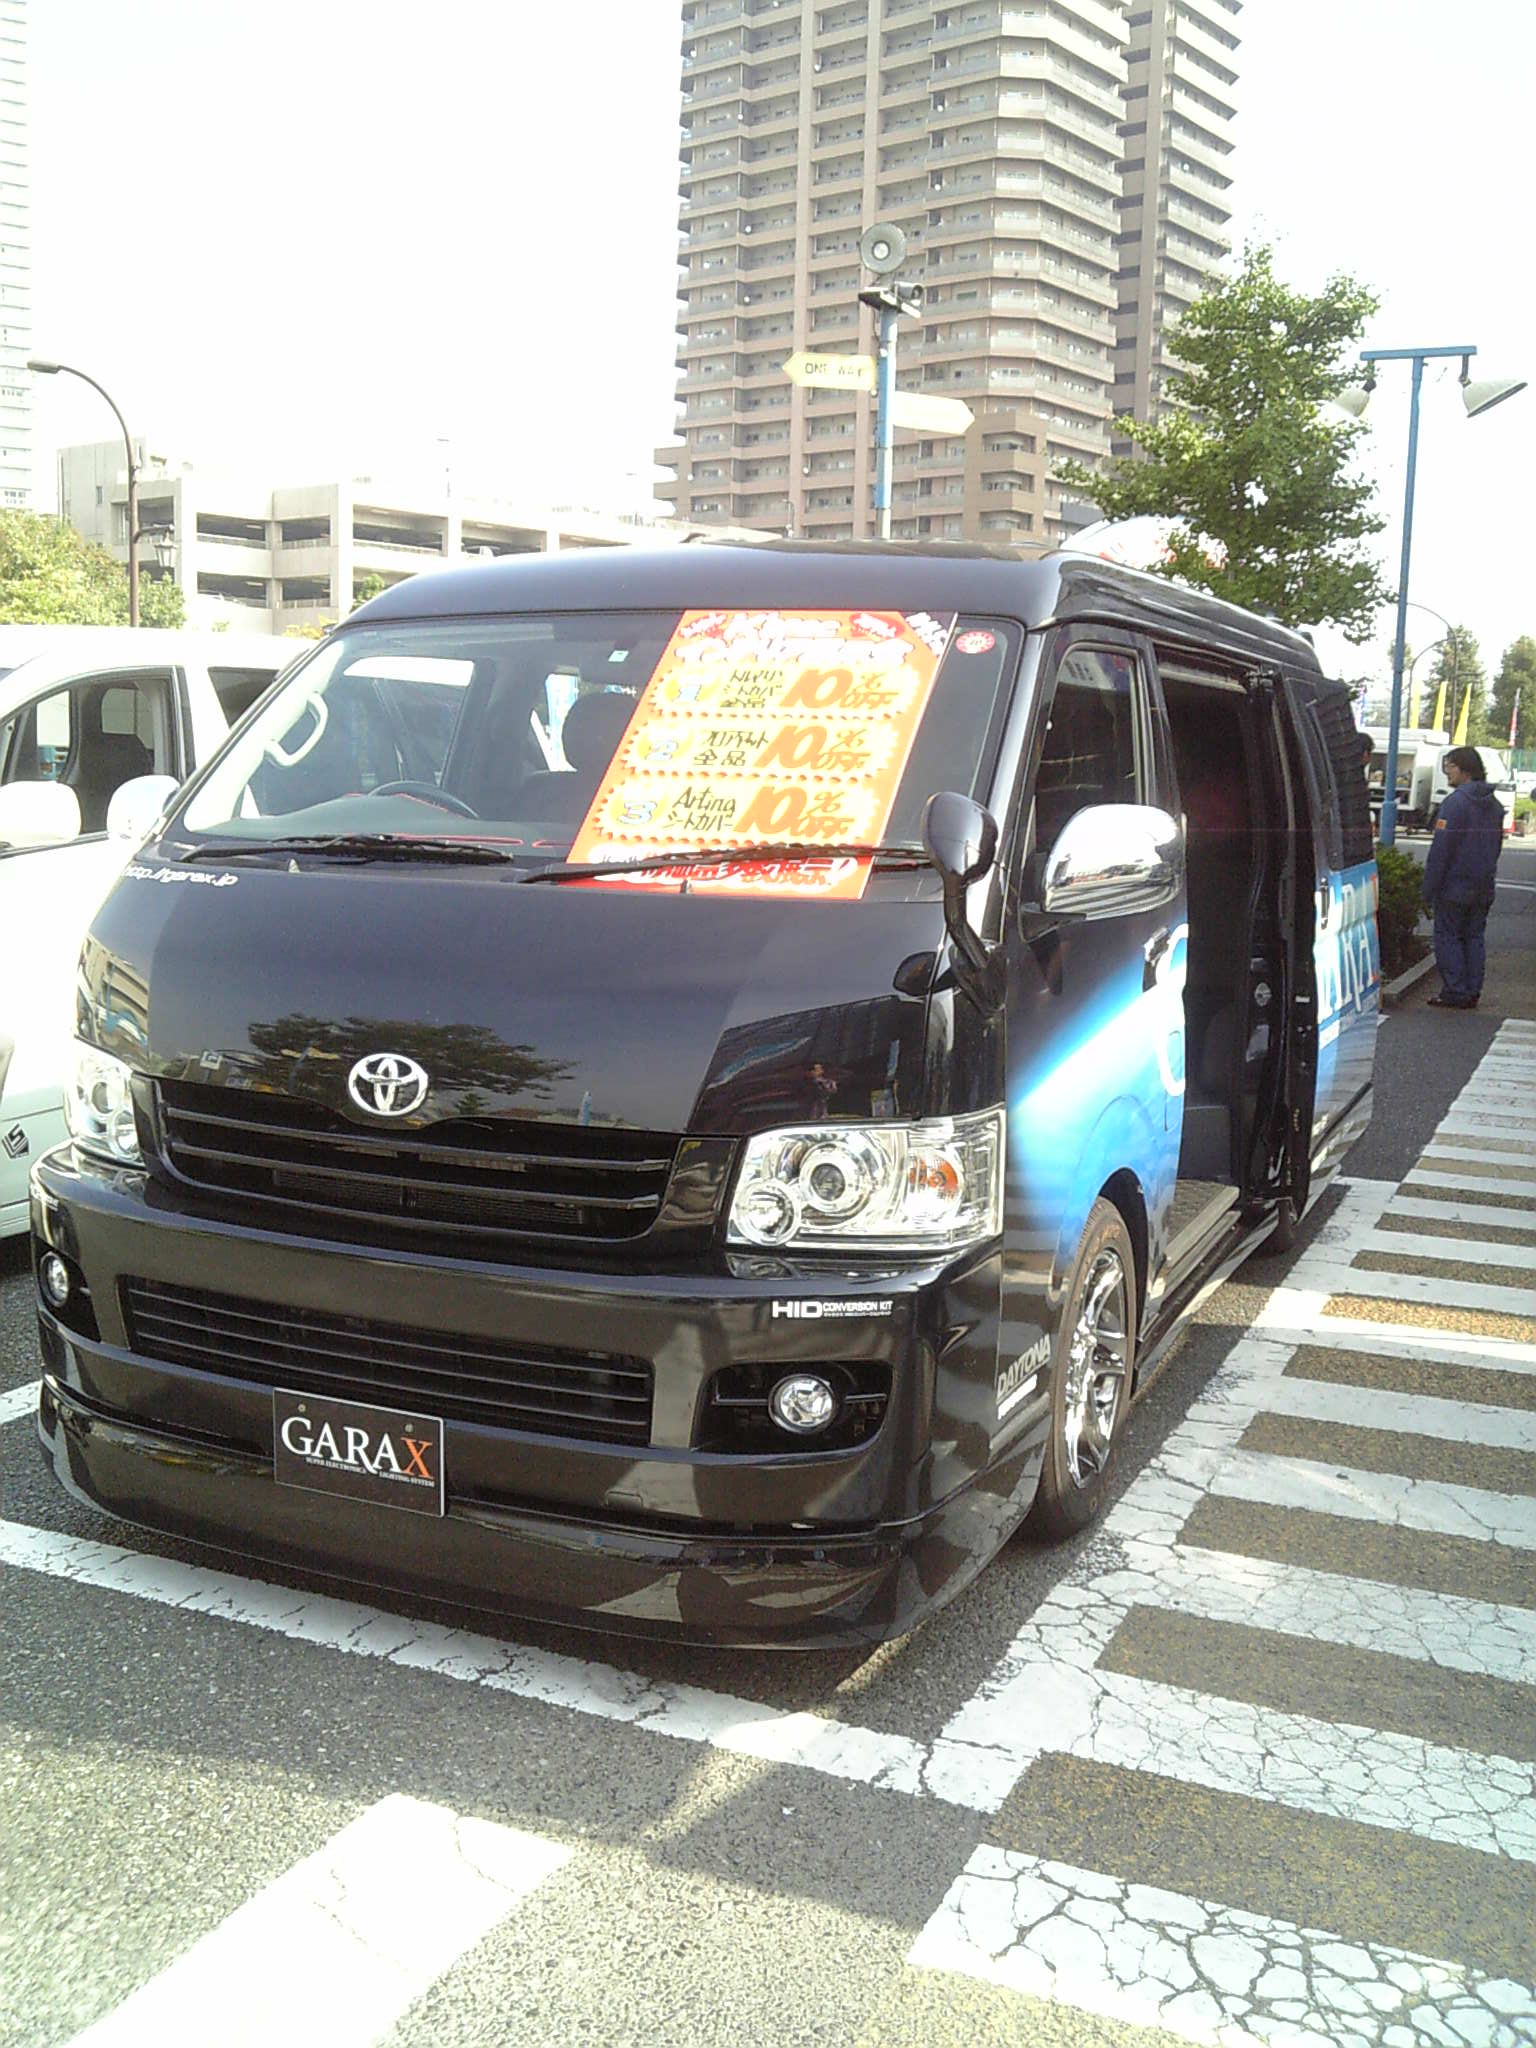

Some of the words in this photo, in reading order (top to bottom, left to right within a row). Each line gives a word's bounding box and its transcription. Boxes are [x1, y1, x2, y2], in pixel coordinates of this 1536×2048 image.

[780, 669, 853, 709] 10
[693, 749, 746, 767] 全品
[754, 726, 822, 769] 10
[672, 786, 736, 818] Arting
[733, 786, 808, 834] 10
[772, 1300, 822, 1319] HID
[823, 1301, 878, 1312] CONVERSION
[880, 1300, 894, 1311] KIT
[996, 1332, 1051, 1400] DAYTONA
[281, 1416, 434, 1480] GARAX
